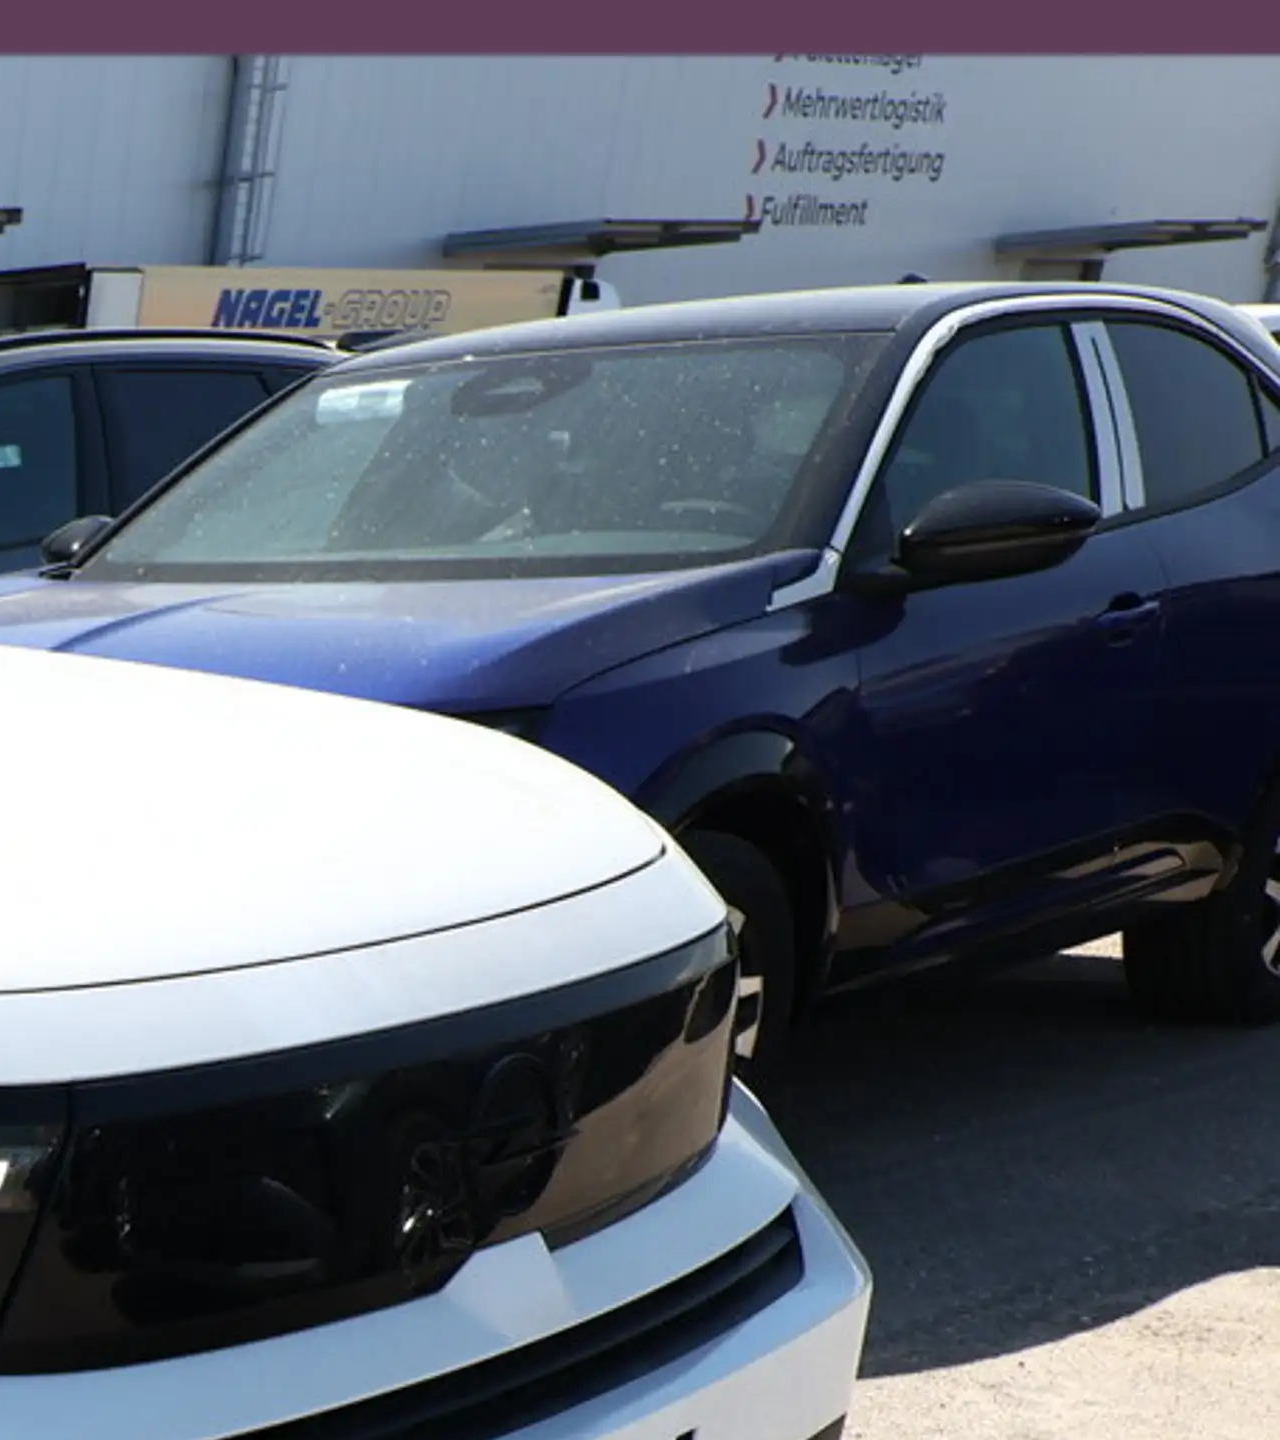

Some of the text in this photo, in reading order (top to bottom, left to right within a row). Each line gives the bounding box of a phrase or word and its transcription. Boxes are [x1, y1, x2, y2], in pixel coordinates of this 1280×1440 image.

[782, 85, 947, 130] Mehrwertlogistik
[770, 142, 945, 182] Auftragsfertigung
[760, 194, 868, 226] Fulfillment
